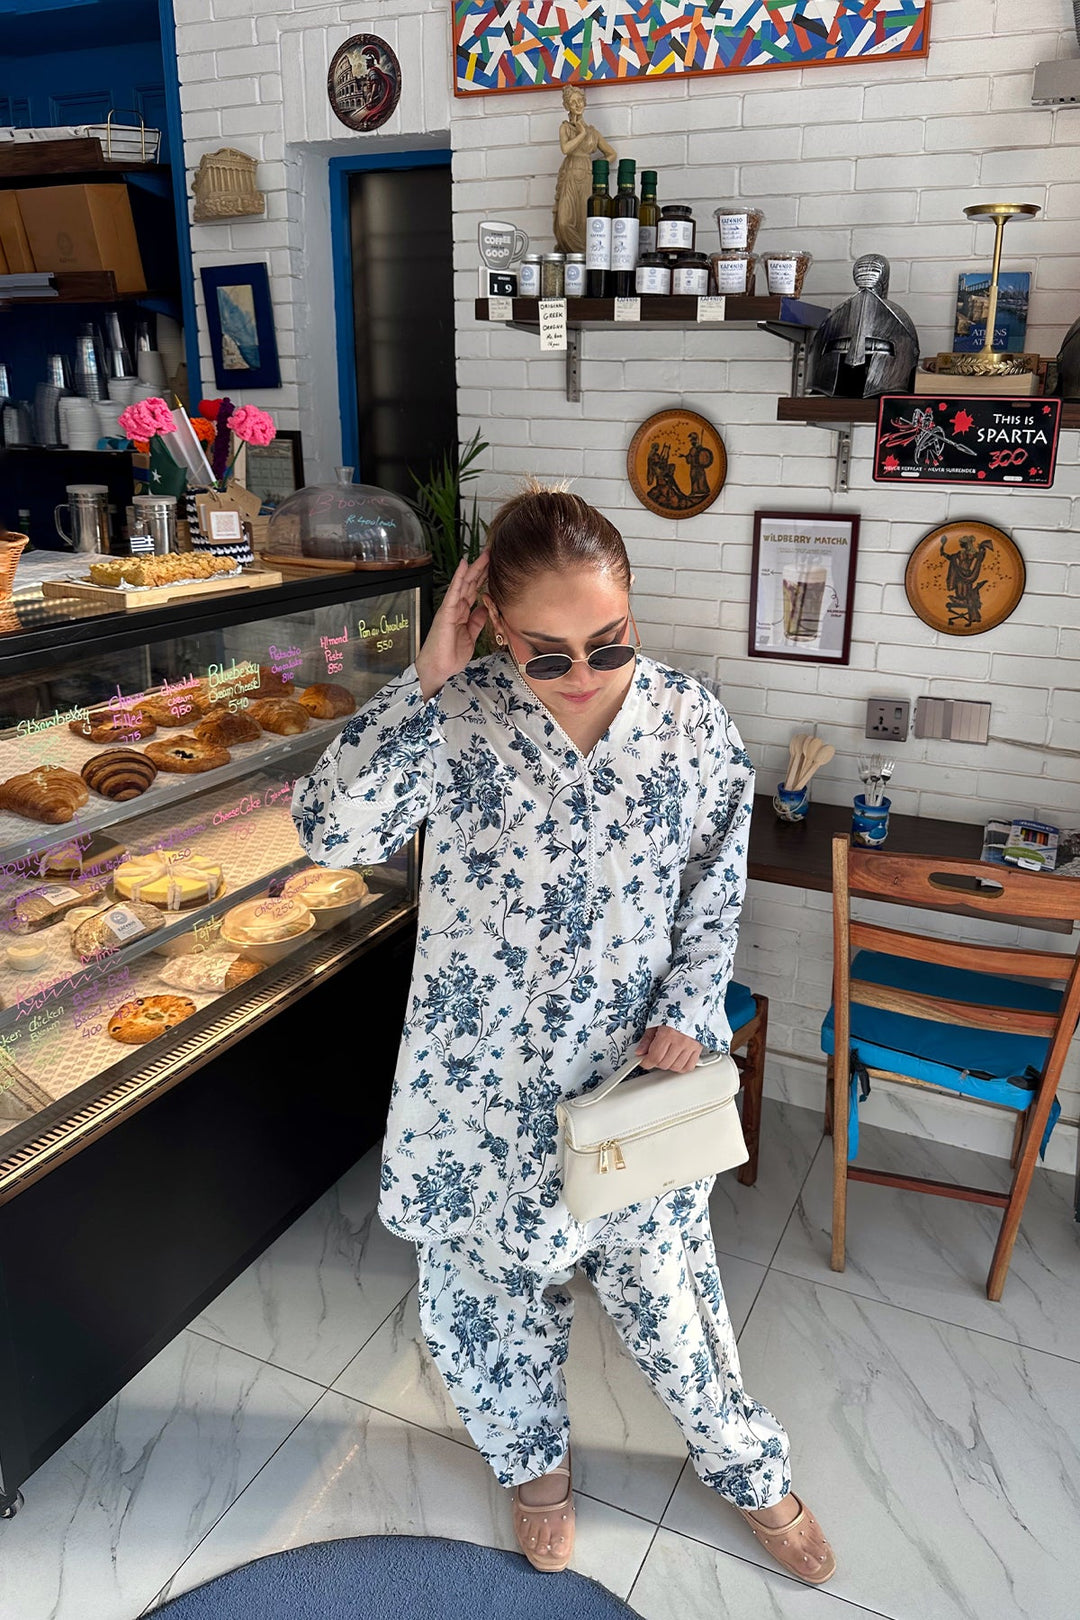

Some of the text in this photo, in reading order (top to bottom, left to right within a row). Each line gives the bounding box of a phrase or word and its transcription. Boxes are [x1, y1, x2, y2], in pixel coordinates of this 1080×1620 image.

[484, 235, 511, 245] COFFEE
[485, 248, 510, 258] GOOD
[543, 312, 563, 320] GREEK
[993, 413, 1034, 425] THIS IS
[977, 427, 1048, 445] SPARTA
[988, 447, 1029, 470] 300
[814, 537, 848, 545] MATCHA
[319, 625, 349, 650] Almond
[268, 645, 302, 661] Pistachio
[376, 639, 394, 653] 550
[324, 649, 344, 663] Paste
[208, 658, 261, 689] Blueberry
[327, 663, 344, 675] 850
[281, 671, 295, 684] 810
[170, 704, 193, 718] 950
[228, 697, 249, 714] 590
[16, 704, 93, 739] Strawberry
[113, 710, 143, 729] Filled
[119, 730, 142, 745] 775
[167, 848, 192, 864] 1250
[272, 900, 295, 919] 1250
[82, 1023, 103, 1038] 400
